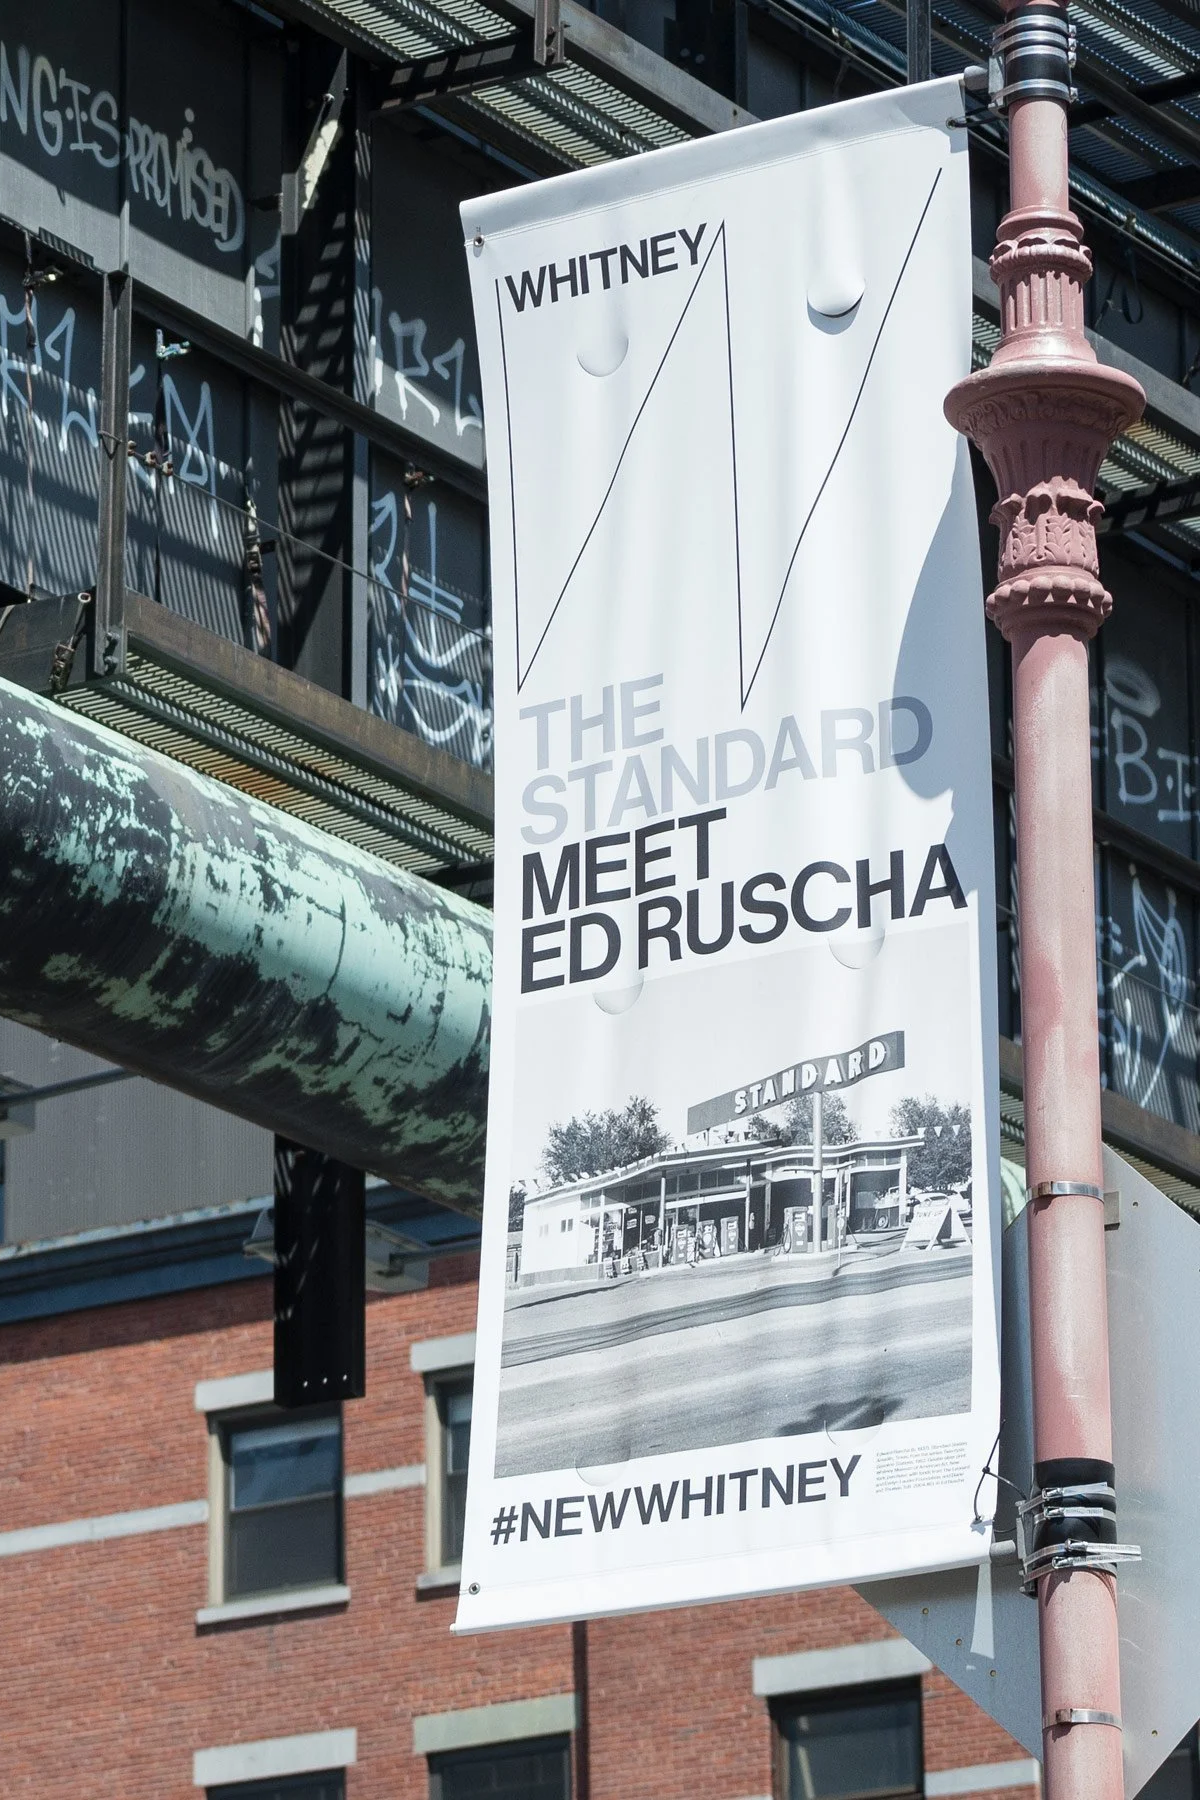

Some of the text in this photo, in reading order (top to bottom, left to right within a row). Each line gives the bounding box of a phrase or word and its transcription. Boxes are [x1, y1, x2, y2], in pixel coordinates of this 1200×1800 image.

[504, 222, 707, 313] WHITNEY
[519, 673, 664, 771] THE
[520, 696, 934, 845] STANDARD
[522, 808, 727, 921] MEET
[520, 843, 969, 994] ED RUSCHA
[734, 1040, 887, 1115] STANDARD
[490, 1454, 863, 1546] #NEWWHITNEY
